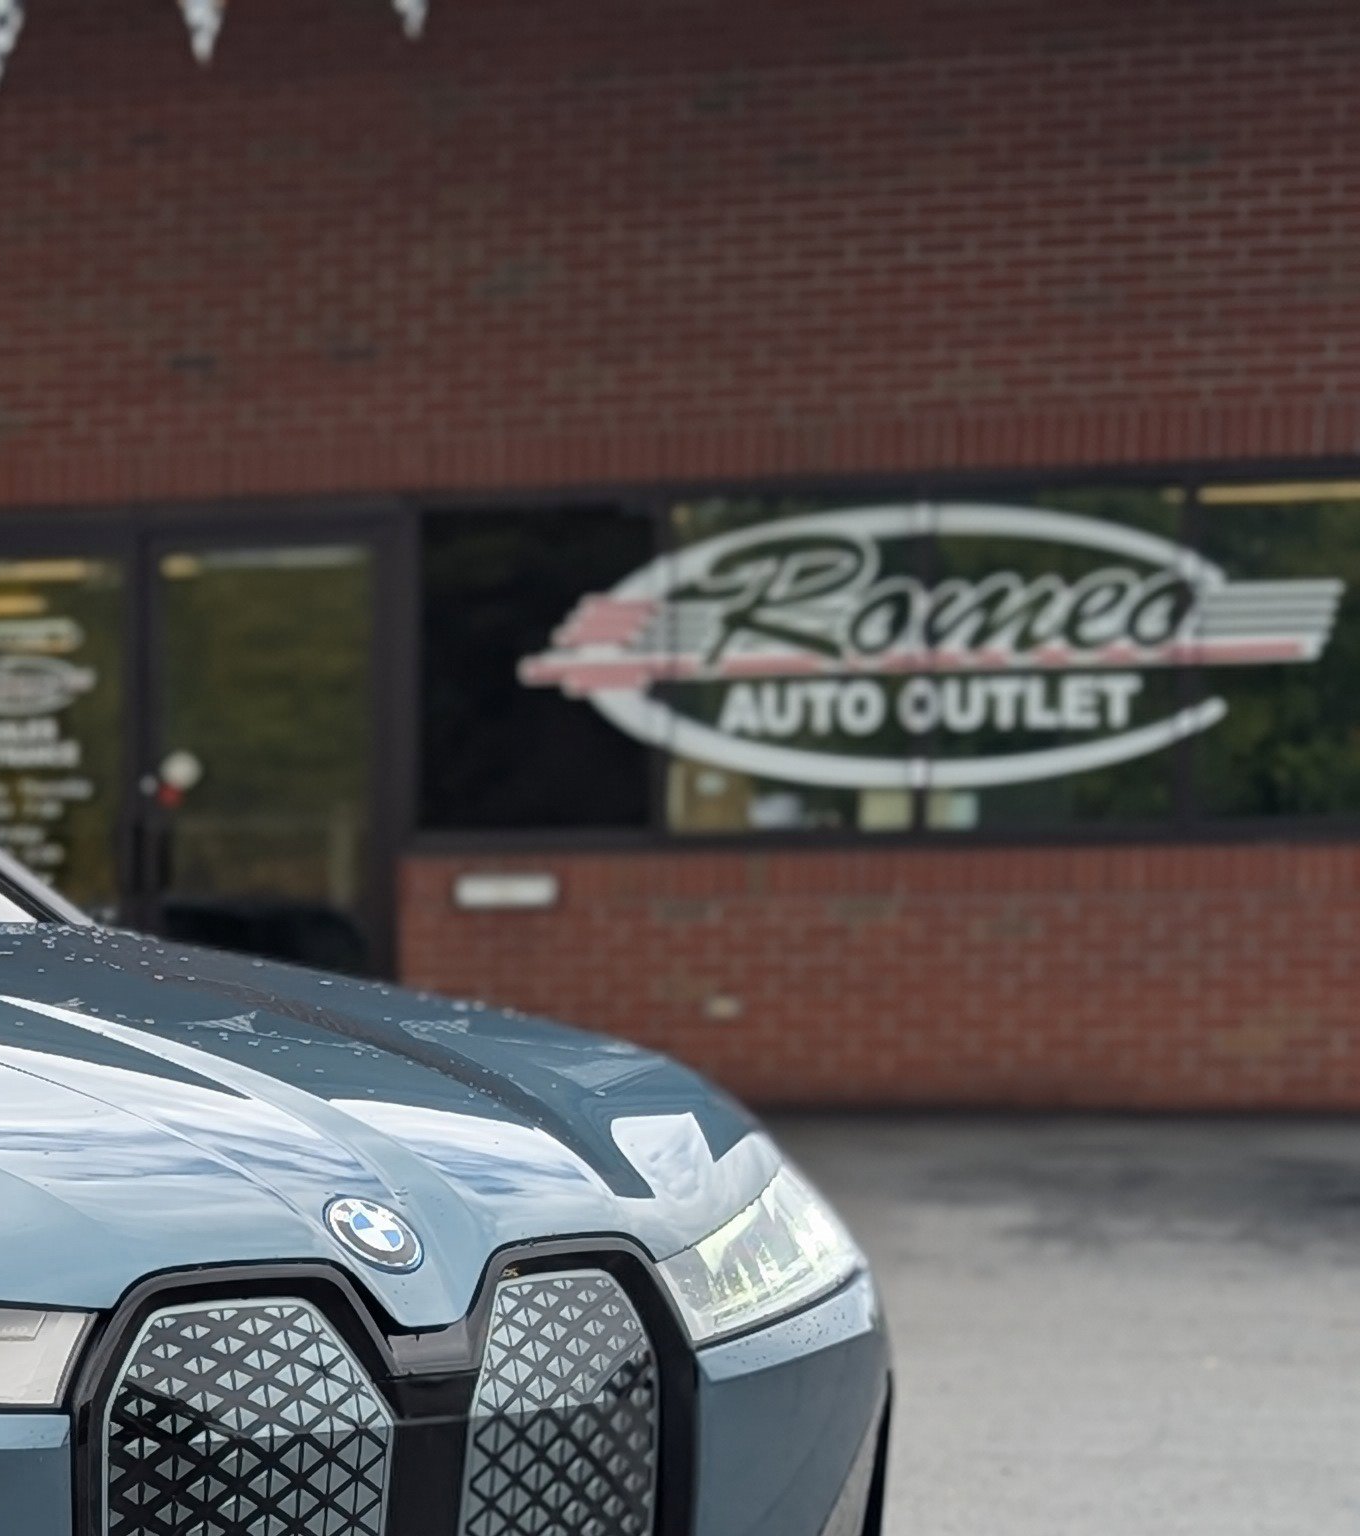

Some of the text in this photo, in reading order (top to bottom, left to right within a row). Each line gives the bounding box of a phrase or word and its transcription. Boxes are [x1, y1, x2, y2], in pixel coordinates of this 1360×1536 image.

[672, 534, 1200, 674] Romeo
[718, 674, 1142, 738] AUTO OUTLET
